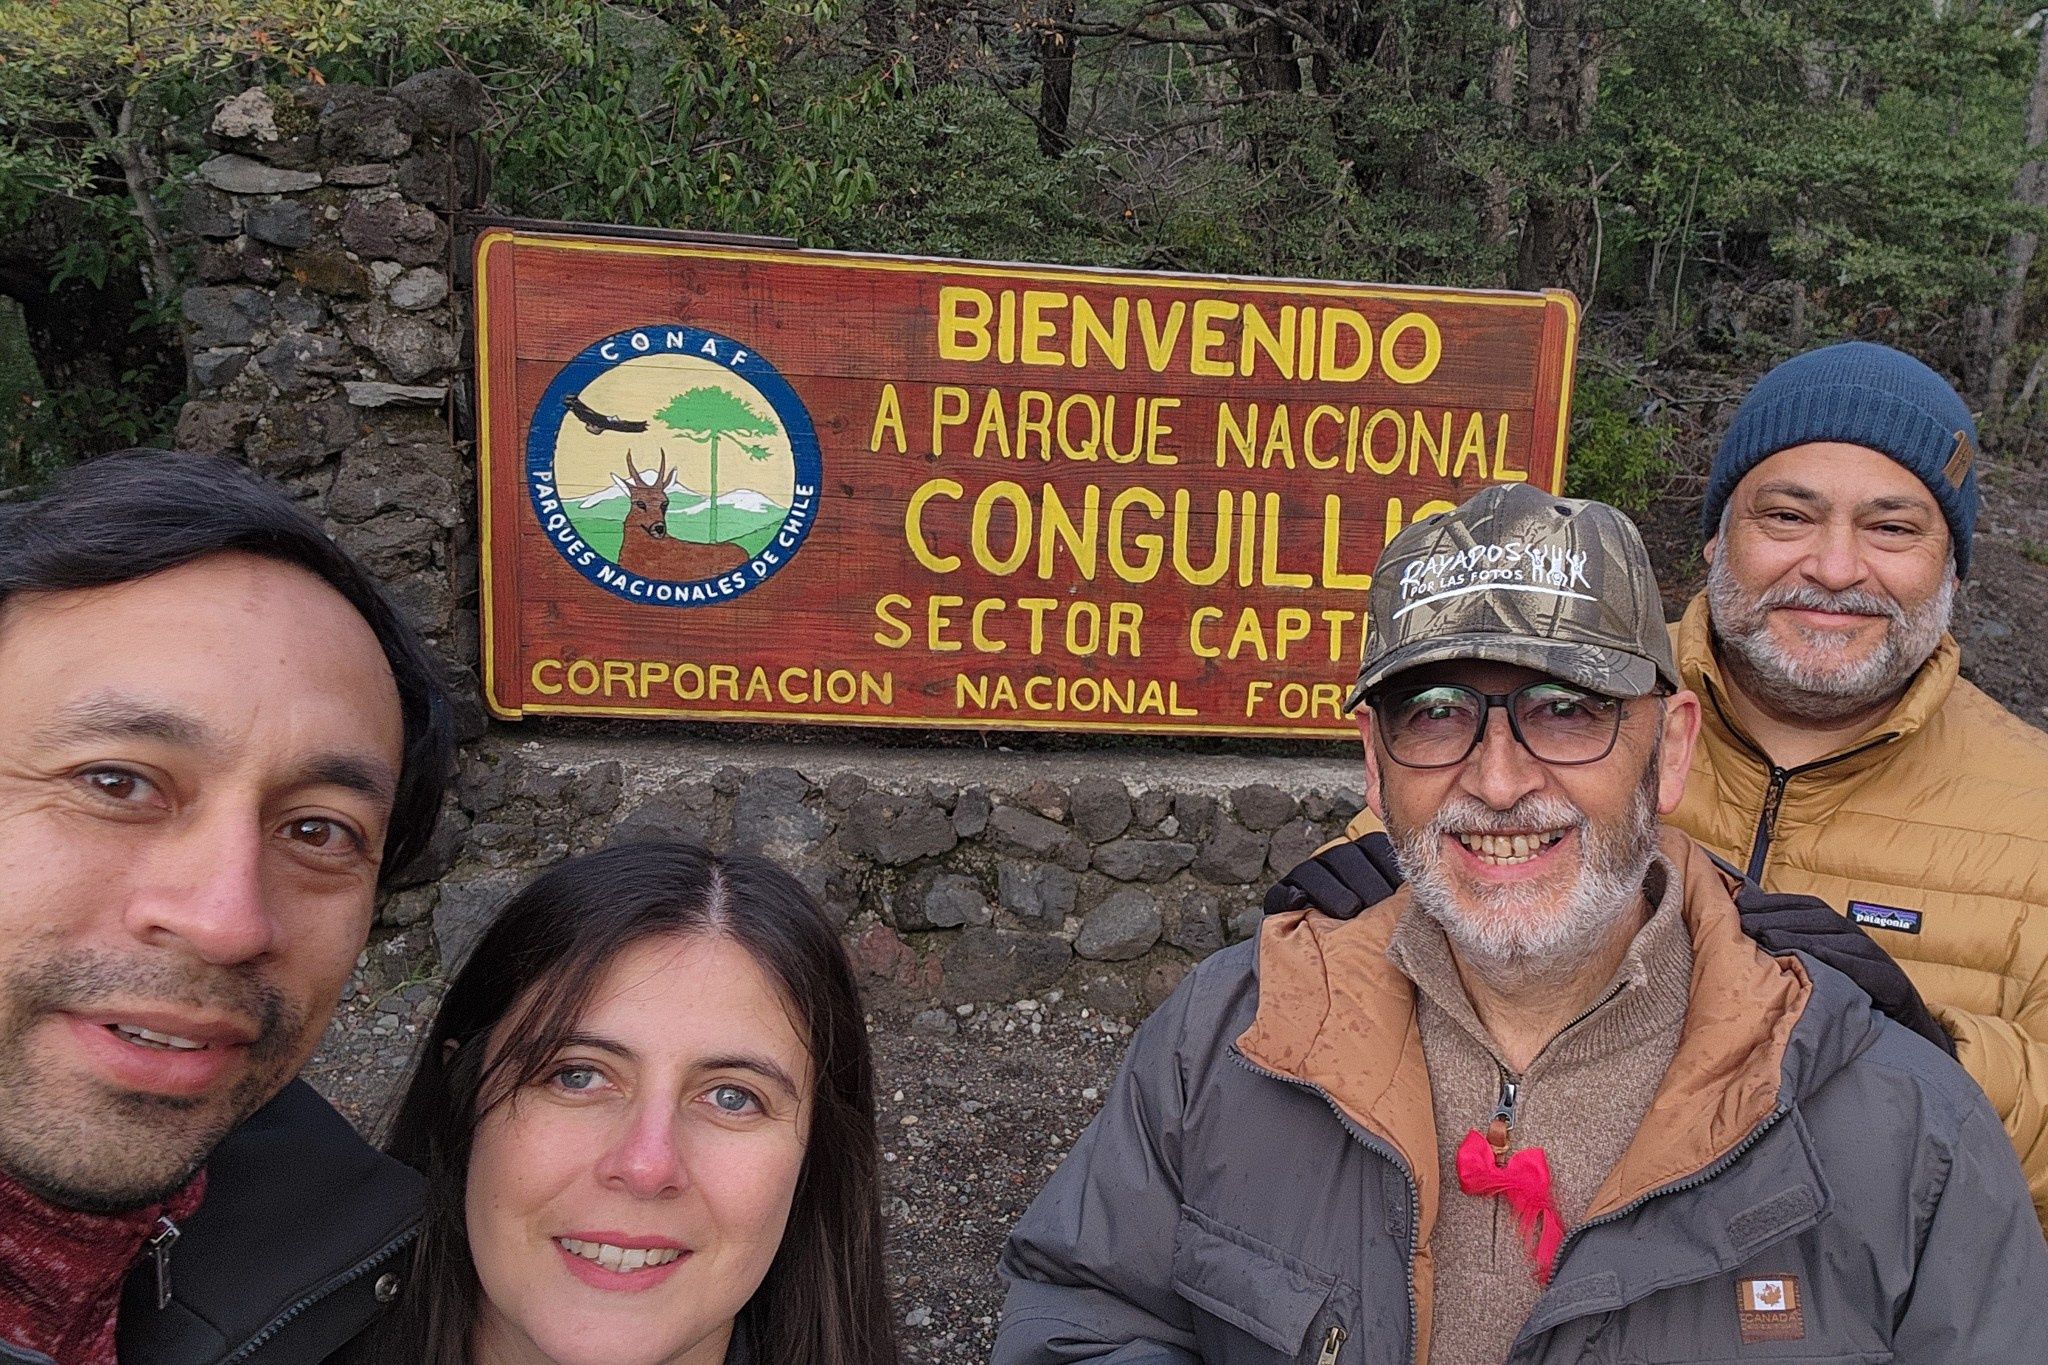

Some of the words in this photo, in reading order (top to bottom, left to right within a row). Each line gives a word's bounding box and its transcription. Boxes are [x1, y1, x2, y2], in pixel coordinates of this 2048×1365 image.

[600, 330, 748, 367] CONAF
[937, 285, 1443, 386] BIENVENIDO
[869, 382, 908, 455] A
[931, 385, 1182, 465] PARQUE
[1214, 402, 1529, 482] NACIONAL
[532, 470, 596, 567] PARQUES
[597, 563, 747, 602] NACIONALES
[752, 551, 779, 580] DE
[778, 484, 815, 548] CHILE
[903, 477, 1457, 592] CONGUILL
[1410, 580, 1435, 597] POR
[1440, 574, 1464, 588] LAS
[1471, 569, 1523, 582] FOTOS
[873, 592, 1144, 658] SECTOR
[1189, 605, 1369, 663] CAPT
[530, 658, 894, 706] CORPORACION
[955, 673, 1198, 719] NACIONAL
[1856, 913, 1910, 928] patagonia
[1745, 1313, 1796, 1323] CANADA
